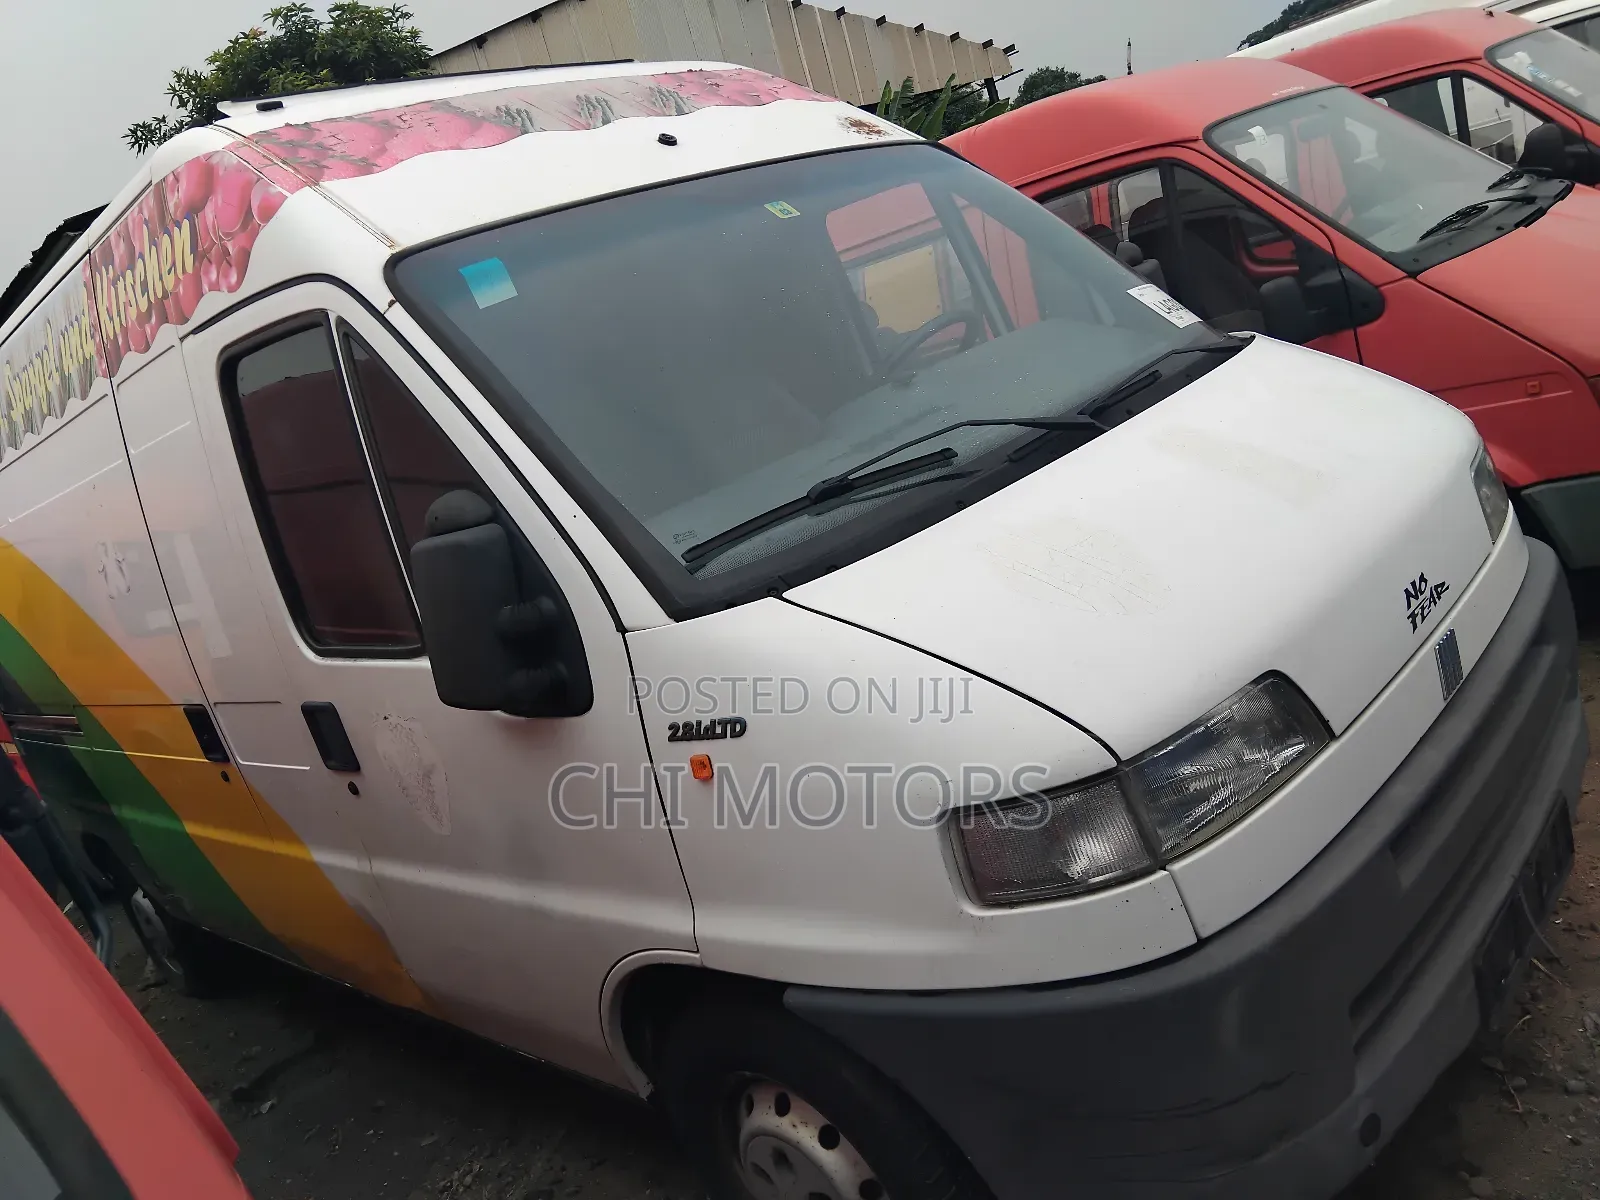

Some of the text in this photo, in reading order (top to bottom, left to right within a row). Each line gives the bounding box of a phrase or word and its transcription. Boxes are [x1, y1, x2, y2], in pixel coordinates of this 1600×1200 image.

[60, 281, 95, 376] und
[96, 214, 194, 344] Kirschen
[1404, 572, 1428, 611] NO
[1407, 581, 1450, 635] FEAR
